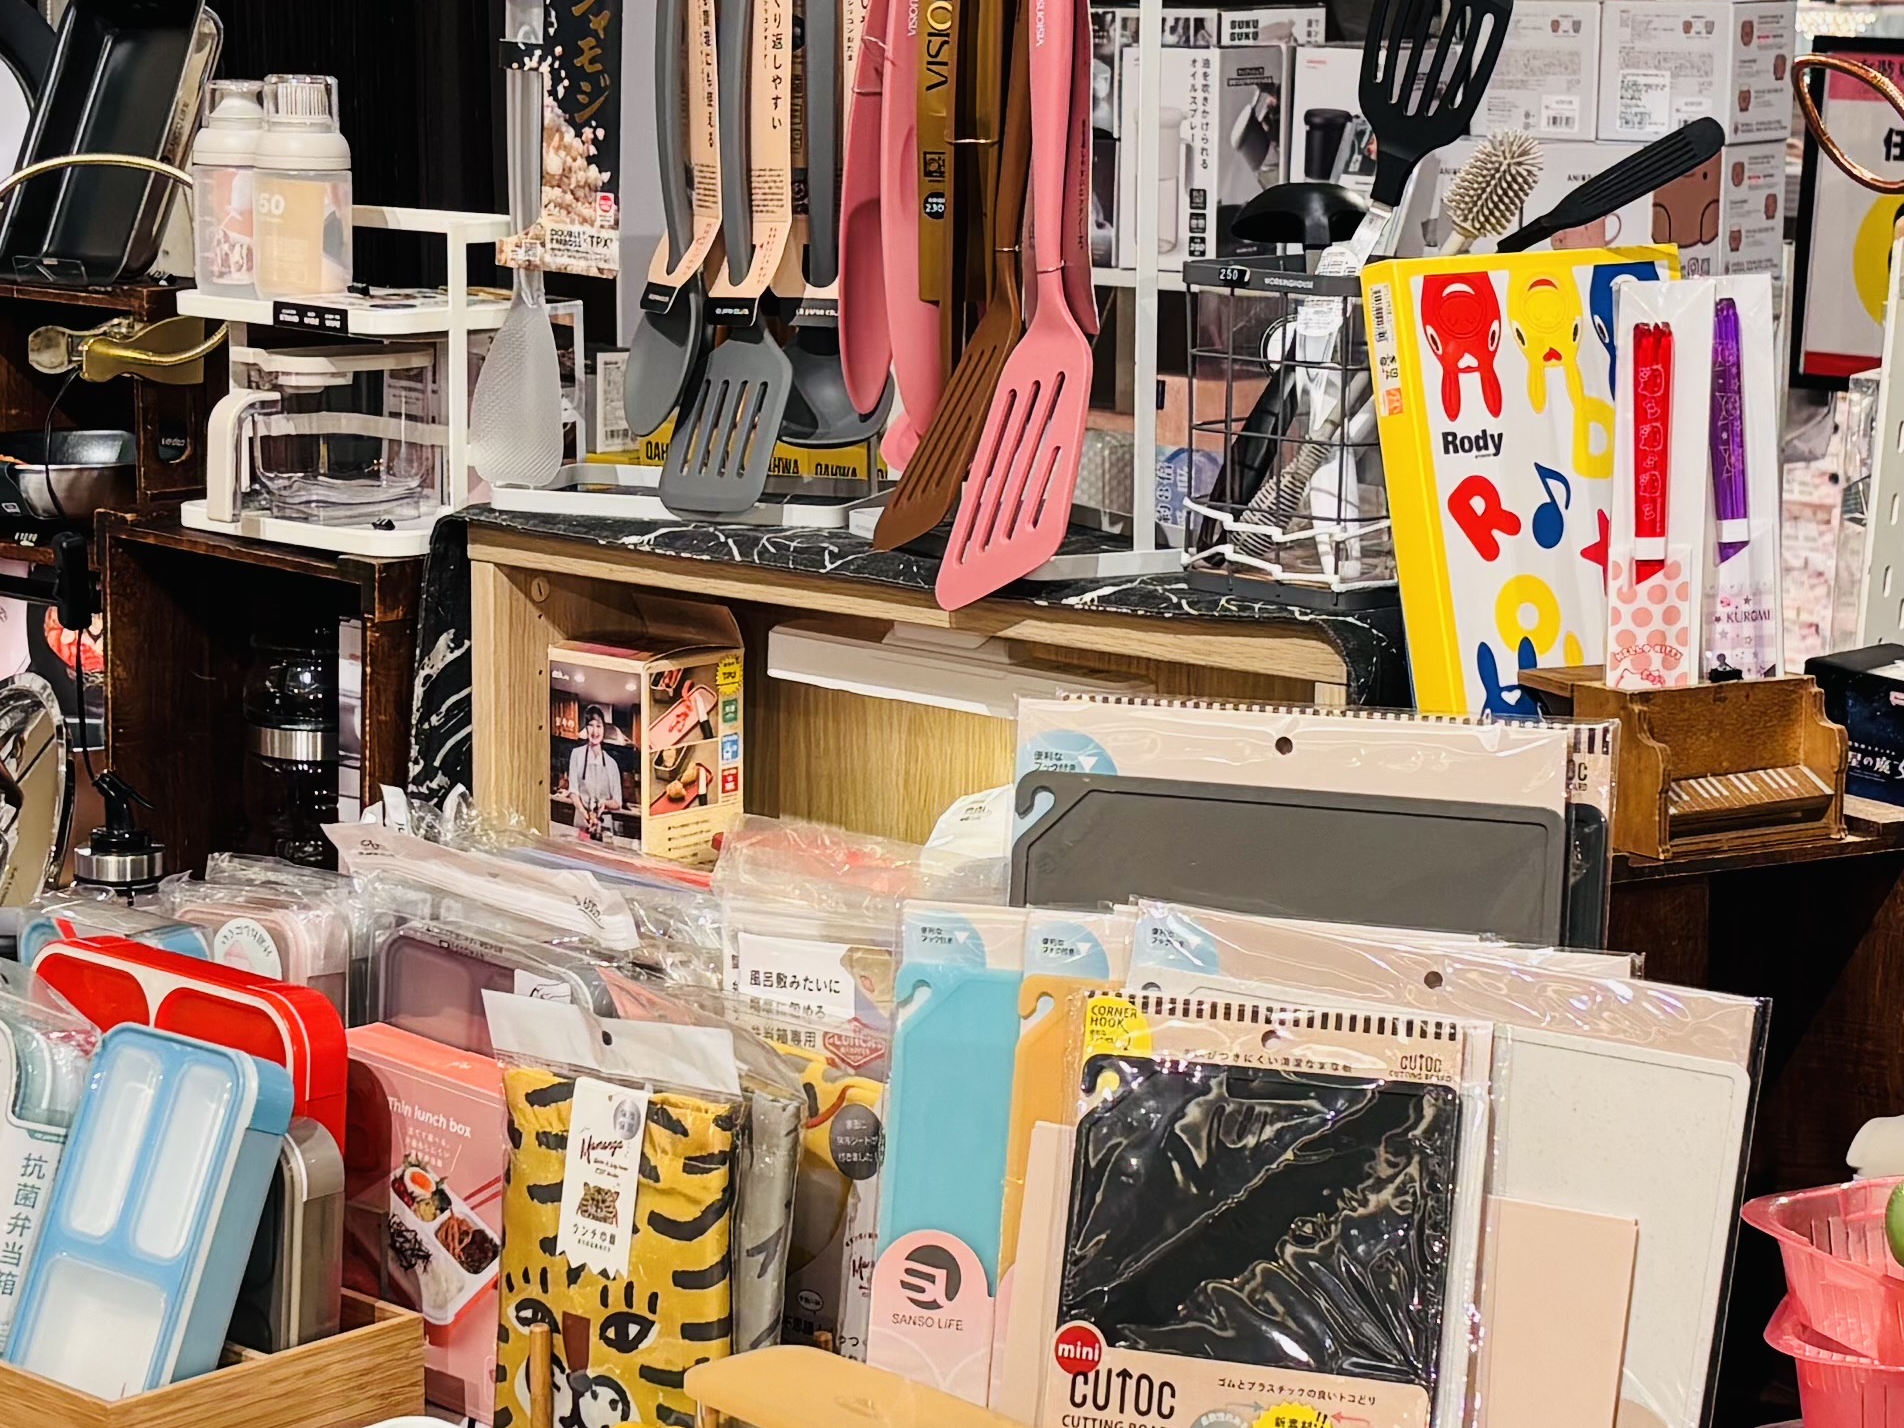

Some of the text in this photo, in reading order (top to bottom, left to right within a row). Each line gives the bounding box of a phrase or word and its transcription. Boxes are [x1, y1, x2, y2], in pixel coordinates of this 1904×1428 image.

[645, 439, 672, 462] QAH
[1441, 429, 1504, 459] Rody
[1725, 606, 1772, 624] KUROMI
[749, 968, 842, 996] 風呂敷みたいに
[1089, 1004, 1138, 1020] CORNER
[1089, 1015, 1125, 1030] HOOK
[413, 1103, 448, 1130] lunch
[449, 1116, 473, 1139] box
[891, 1312, 964, 1332] SANSO LIFE
[1057, 1340, 1100, 1364] mini
[1068, 1367, 1177, 1421] CUTOC
